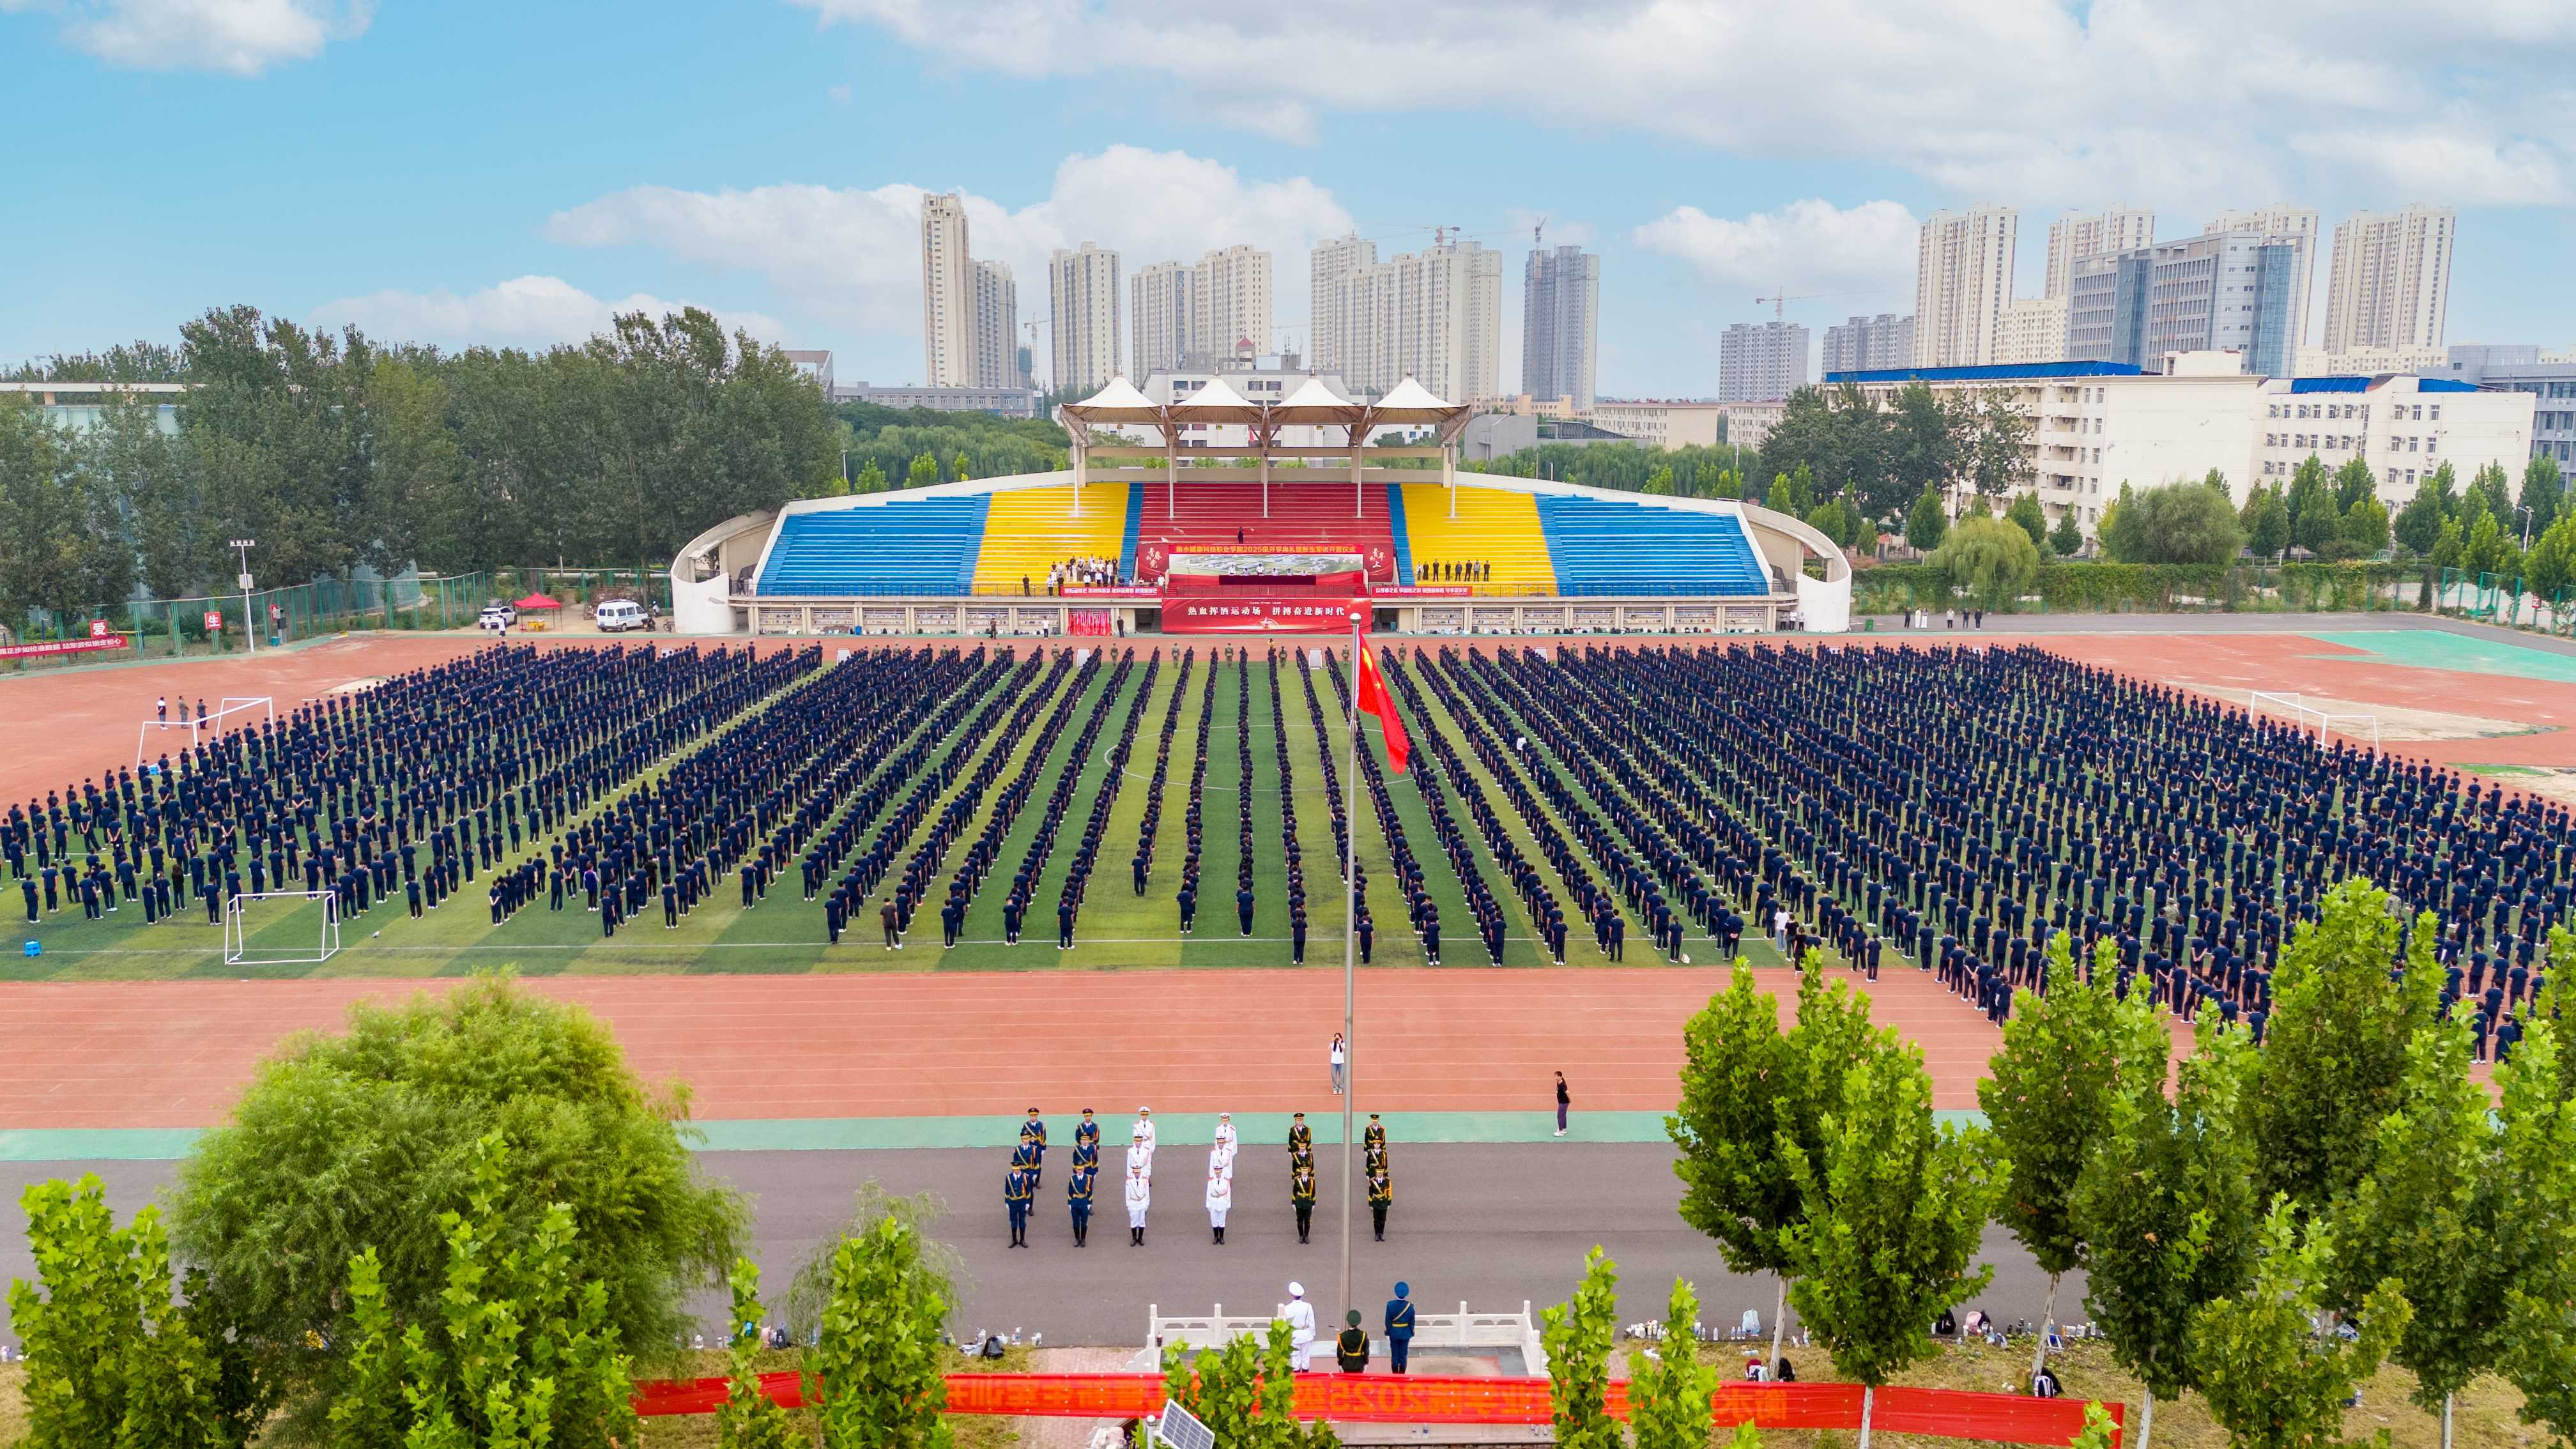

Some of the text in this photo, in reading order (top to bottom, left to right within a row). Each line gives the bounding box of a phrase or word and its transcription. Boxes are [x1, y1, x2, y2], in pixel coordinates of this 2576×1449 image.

[1188, 606, 1345, 616] 热血挥洒运动场 拼搏奋进新时代
[207, 615, 220, 628] 生
[93, 622, 107, 636] 爱
